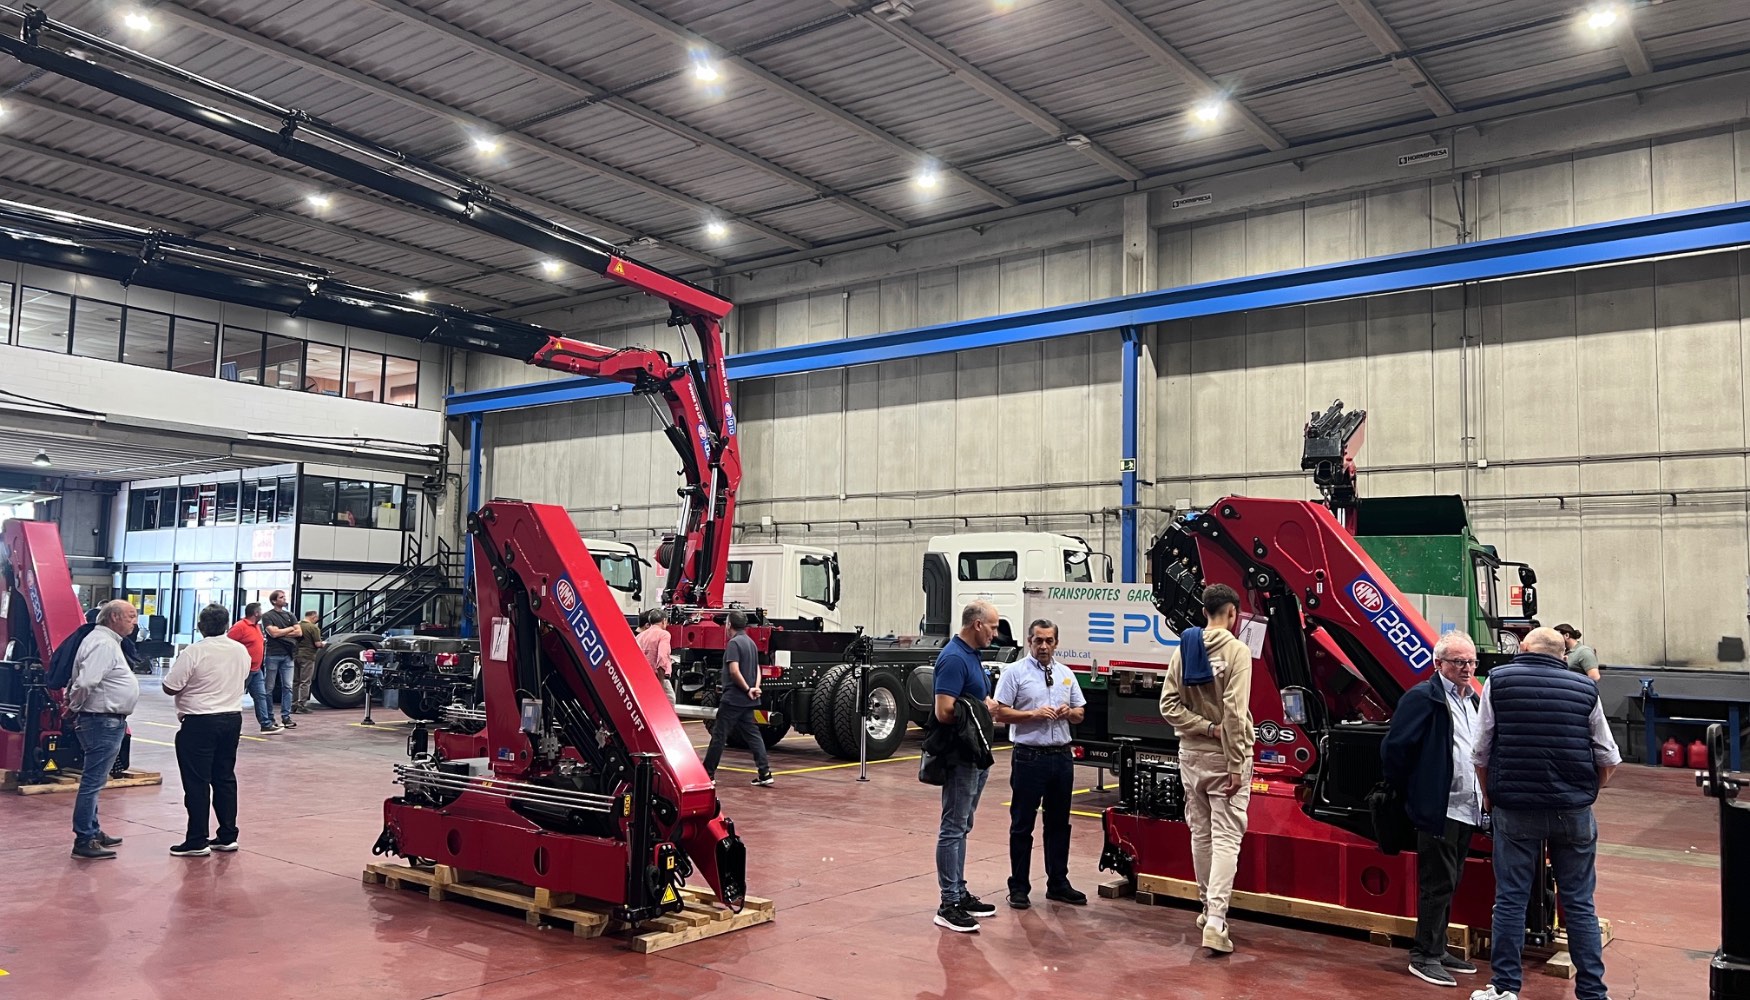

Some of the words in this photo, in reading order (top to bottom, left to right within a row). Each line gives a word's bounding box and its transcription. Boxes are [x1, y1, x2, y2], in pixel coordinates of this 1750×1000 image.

[1407, 149, 1447, 161] HORMIPRESA
[558, 582, 574, 607] HMF
[1047, 587, 1121, 601] TRANSPORTES
[1355, 583, 1380, 608] HMF
[571, 609, 605, 666] 1320
[1375, 610, 1432, 669] 2820
[1054, 649, 1091, 659] w.plb.cat
[604, 660, 626, 697] POWER
[623, 694, 633, 711] TO
[630, 710, 645, 732] LIFT
[1090, 750, 1109, 758] IVECO
